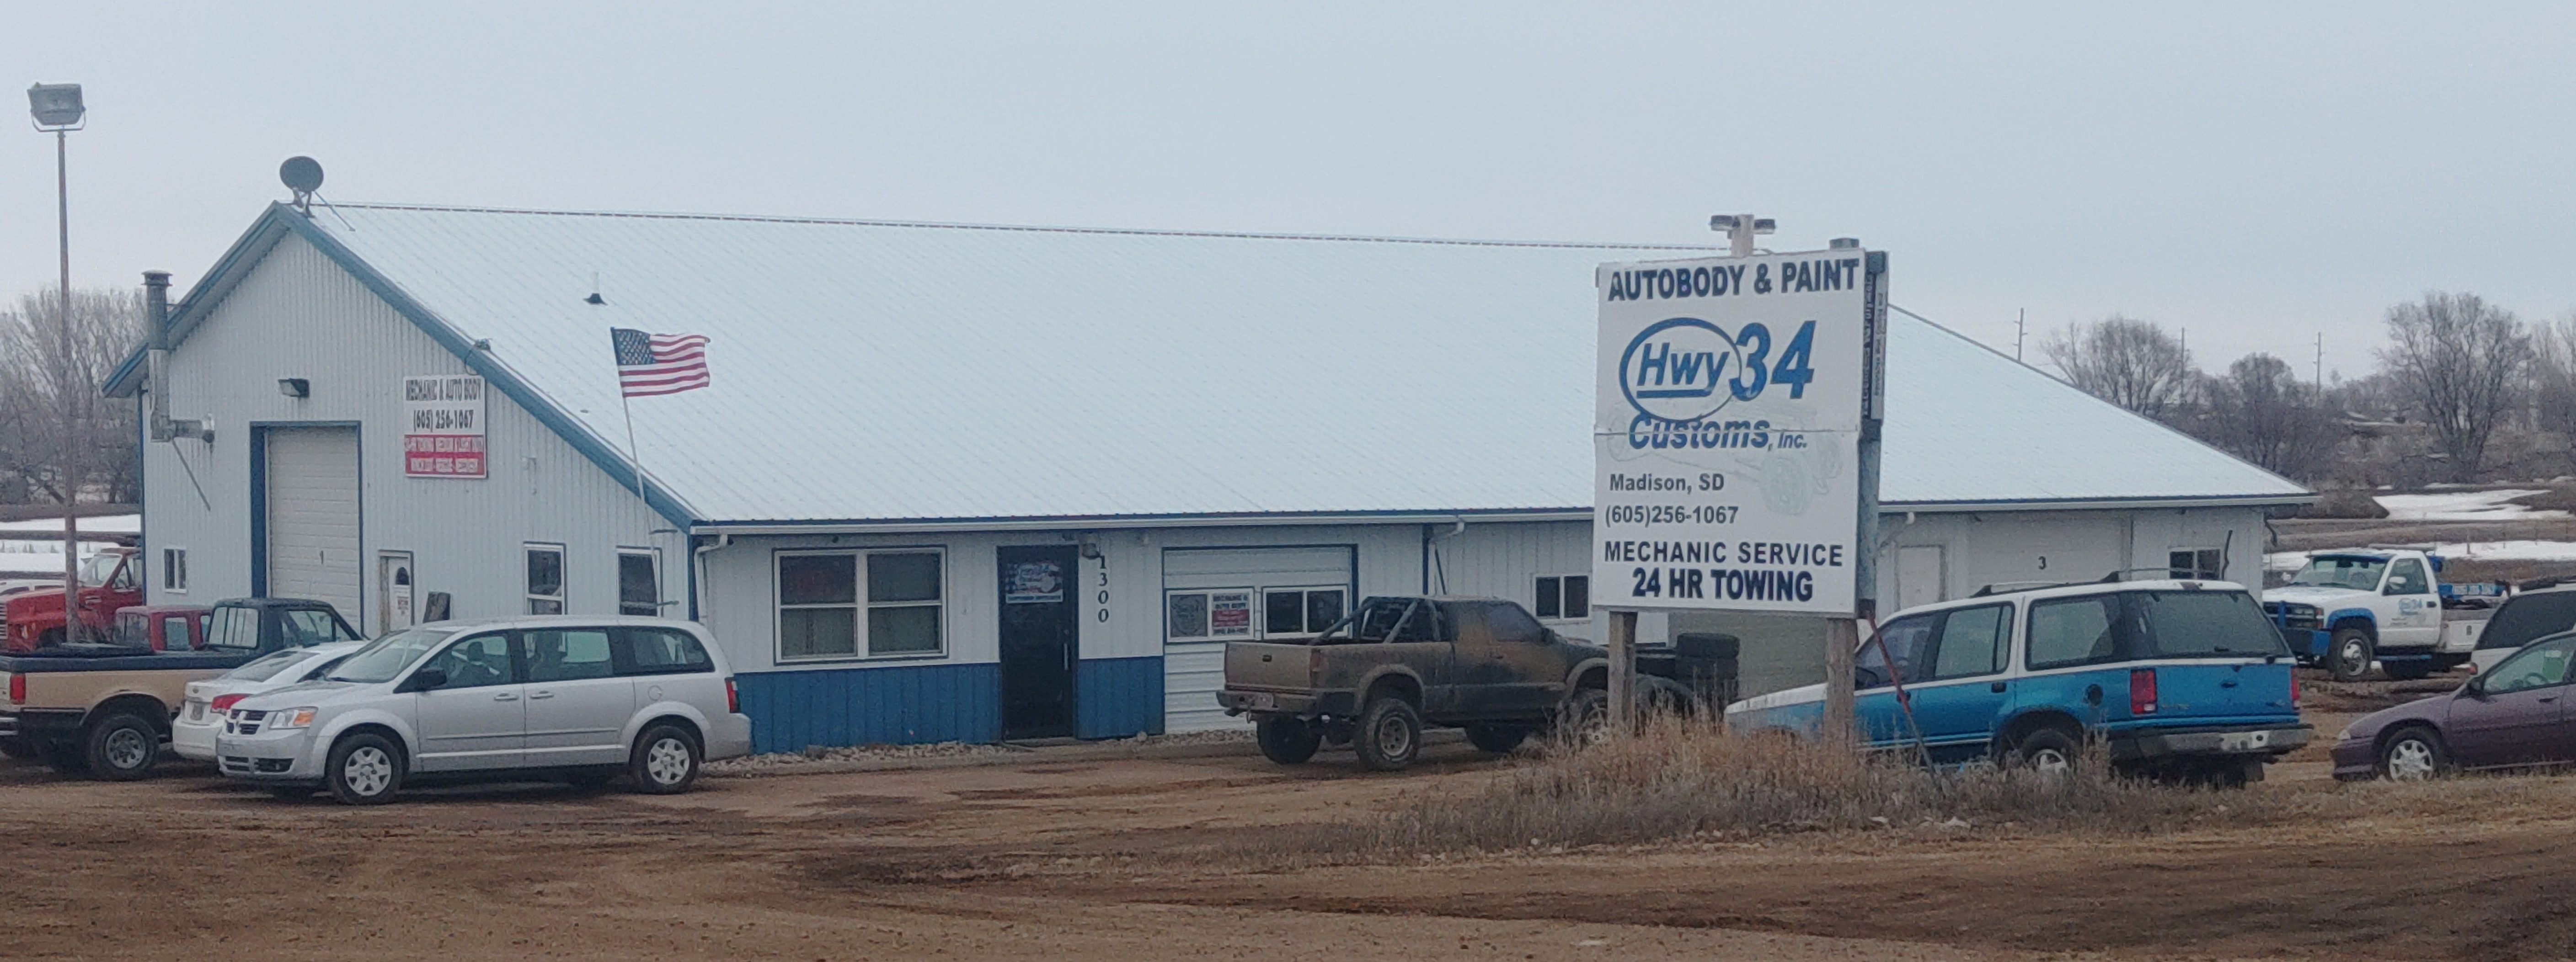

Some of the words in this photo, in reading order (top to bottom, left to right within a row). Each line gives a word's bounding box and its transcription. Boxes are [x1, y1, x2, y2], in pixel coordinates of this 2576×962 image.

[1608, 265, 1745, 301] AUTOBODY
[1754, 263, 1772, 294] &
[1781, 258, 1859, 293] PAINT
[1636, 342, 1730, 399] Hwy
[1729, 320, 1816, 401] 34
[446, 378, 462, 401] AUTO
[414, 409, 433, 433] (605)
[435, 409, 474, 429] 256-1067
[1778, 432, 1807, 449] Inc.
[1609, 473, 1692, 494] Madison,
[1699, 473, 1724, 491] SD
[1605, 505, 1738, 527] (605)256-1067
[1604, 541, 1727, 563] MECHANIC
[1737, 542, 1843, 566] SERVICE
[2038, 556, 2047, 570] 3
[1098, 555, 1108, 622] 1300
[1632, 568, 1661, 597] 24
[1669, 569, 1704, 599] HR
[1710, 569, 1813, 602] TOWING
